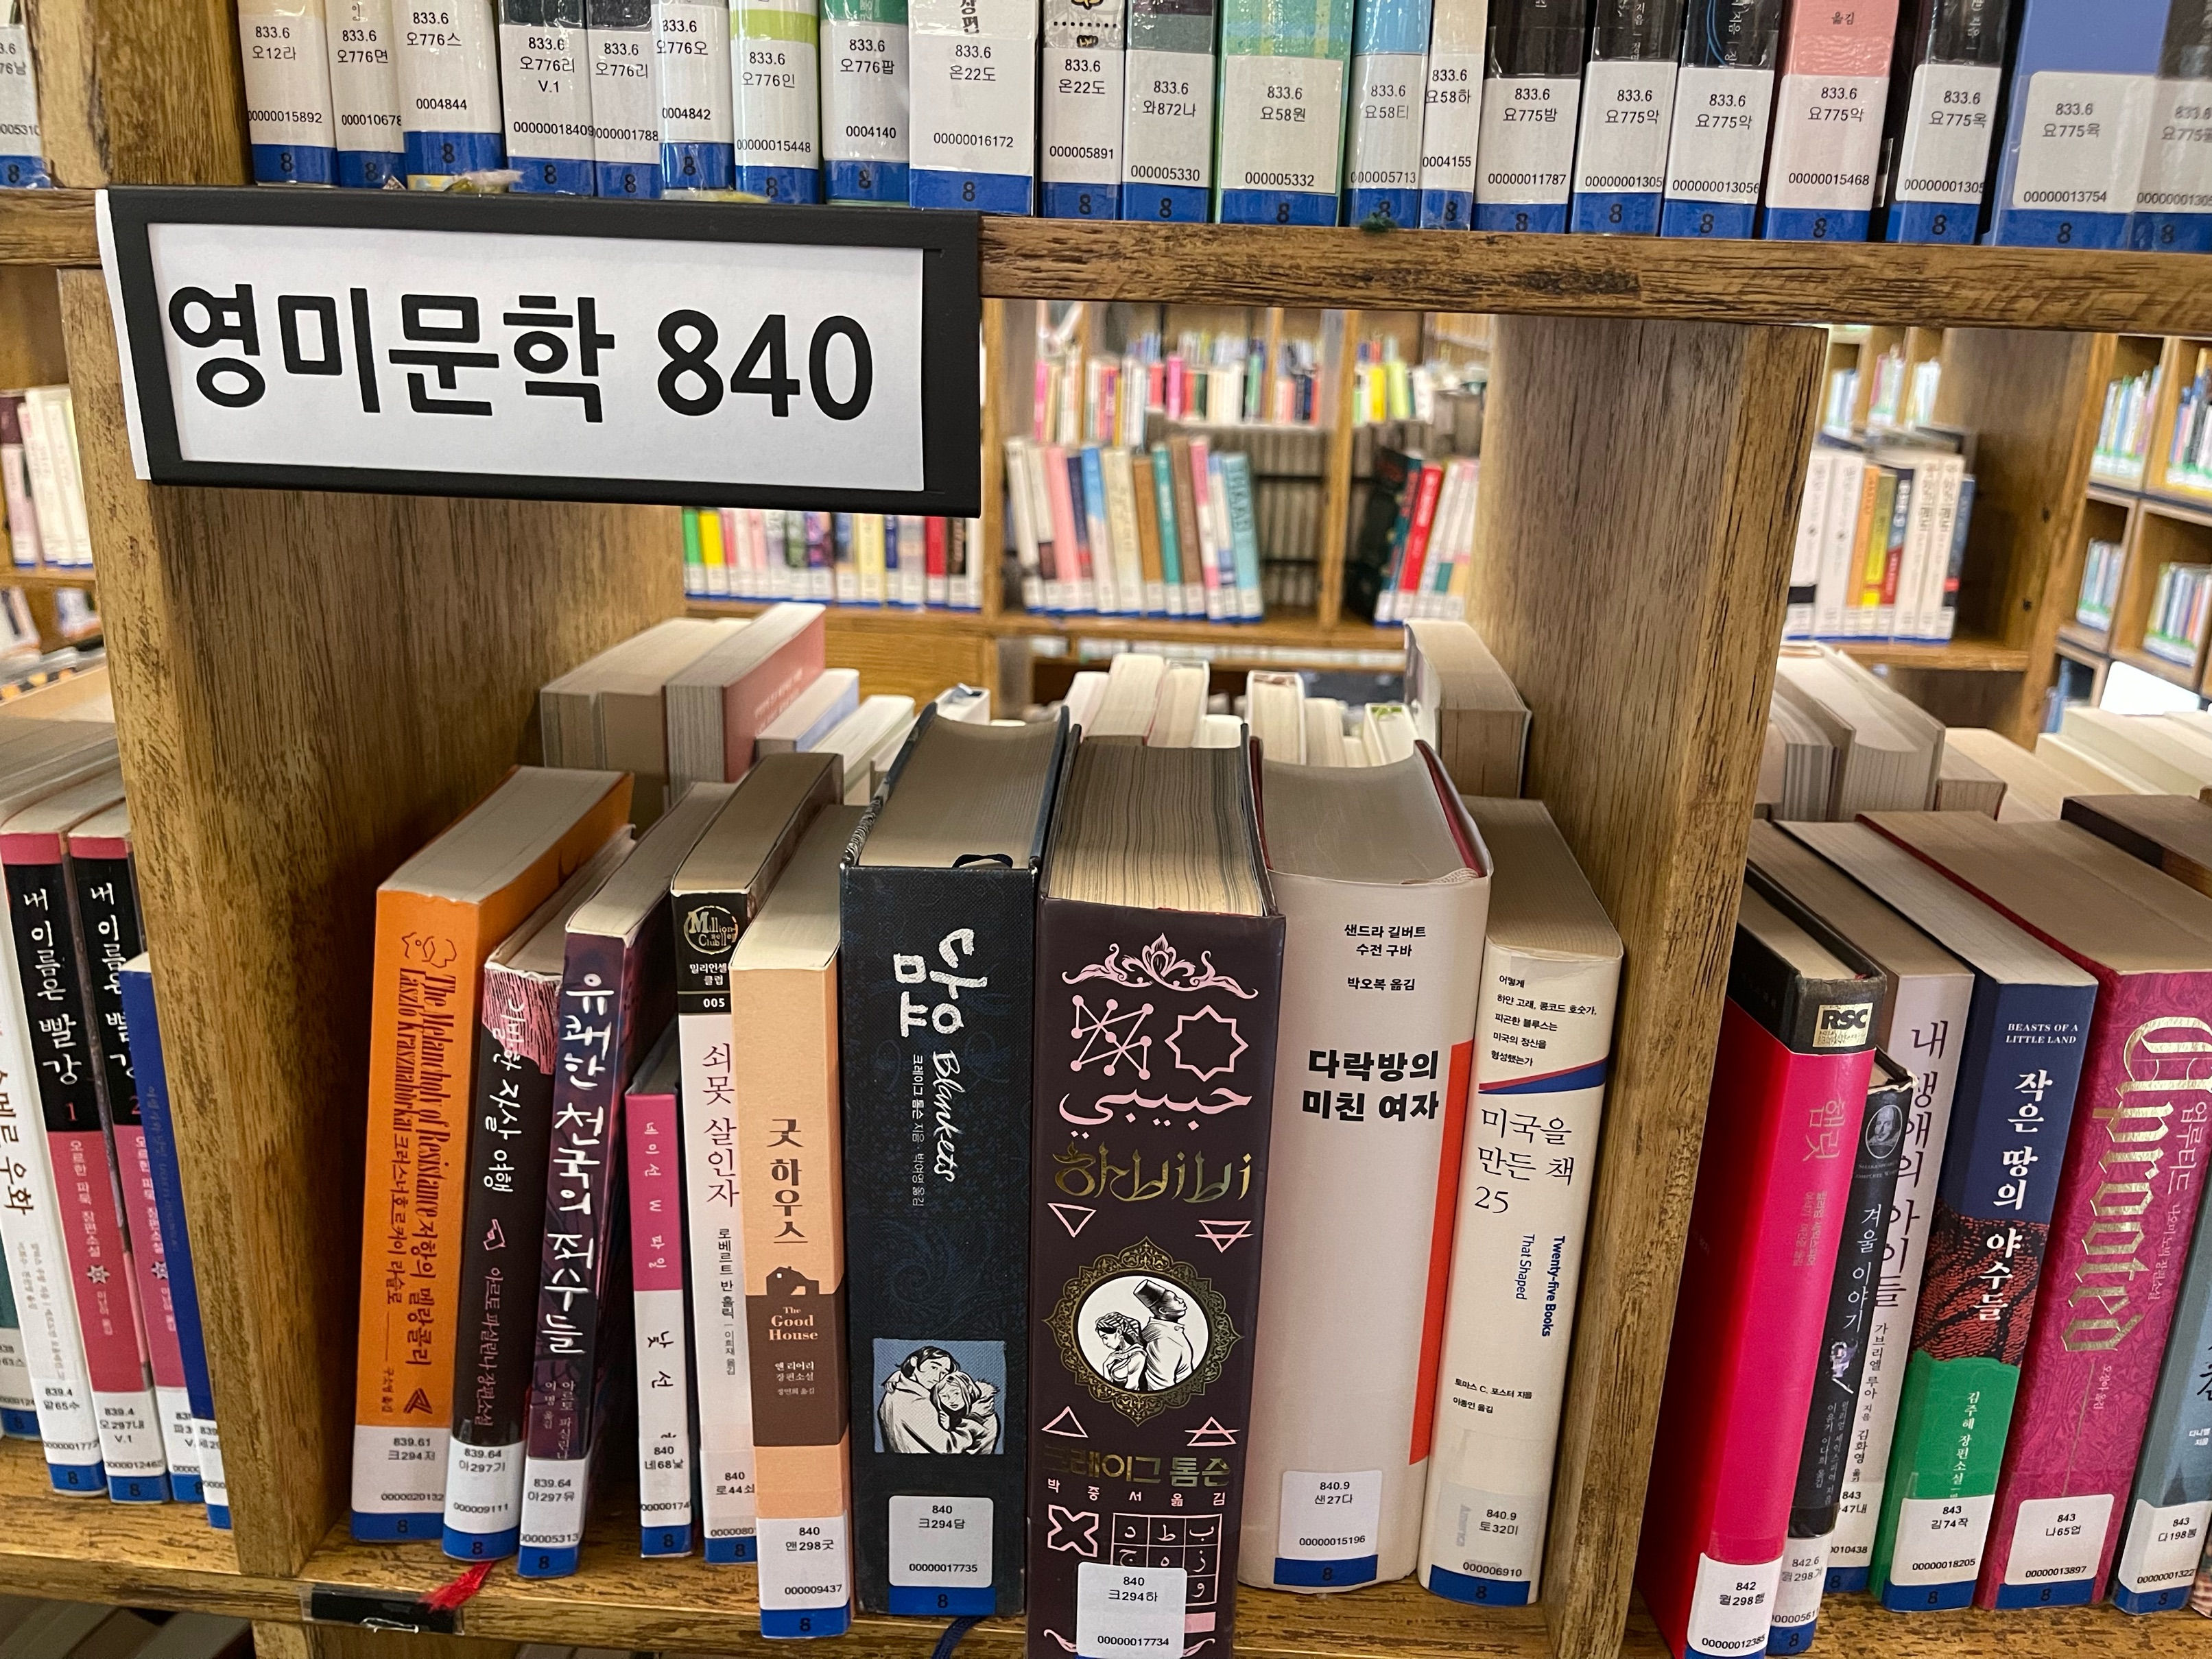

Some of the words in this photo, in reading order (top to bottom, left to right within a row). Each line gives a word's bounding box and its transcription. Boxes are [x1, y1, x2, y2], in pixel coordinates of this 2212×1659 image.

[413, 12, 449, 25] 833.6
[255, 26, 290, 40] 833.6
[342, 29, 377, 43] 833.6
[406, 32, 463, 47] 오776스
[527, 36, 565, 51] 833.6
[604, 42, 639, 56] 833.6
[848, 38, 885, 53] 833.6
[252, 46, 297, 61] 오12라
[337, 49, 389, 65] 오776면
[749, 51, 786, 67] 833.6
[955, 45, 992, 60] 833.6
[519, 56, 575, 73] 오776리
[595, 62, 649, 80] 오776리
[840, 59, 895, 75] 오776팝
[1065, 58, 1101, 73] 833.6
[741, 72, 796, 89] 오776인
[949, 65, 997, 82] 온22도
[1431, 69, 1468, 82] 833.6
[538, 79, 560, 94] V.1
[1058, 79, 1106, 95] 온22도
[1153, 80, 1189, 95] 833.6
[1267, 86, 1303, 101] 833.6
[1370, 84, 1406, 98] 833.6
[1820, 86, 1858, 101] 833.6
[1425, 88, 1472, 105] 요58하
[1514, 88, 1551, 102] 833.6
[1617, 89, 1653, 102] 833.6
[1709, 93, 1746, 108] 833.6
[1942, 91, 1982, 106] 833.6
[416, 97, 468, 111] 0004844
[1143, 100, 1197, 118] 와872나
[2054, 103, 2094, 117] 833.6
[662, 107, 711, 121] 0004842
[1364, 105, 1410, 121] 요58티
[1503, 107, 1558, 123] 요775밤
[1604, 109, 1661, 126] 요775악
[1807, 106, 1865, 123] 요775악
[1695, 113, 1753, 130] 요775악
[846, 125, 896, 139] 0004140
[933, 132, 1014, 149] 00000016172
[1049, 145, 1114, 160] 000005891
[1422, 156, 1472, 169] 0004155
[1130, 165, 1200, 182] 000005330
[1245, 171, 1315, 187] 000005332
[1487, 173, 1566, 186] 00000011787
[1787, 171, 1870, 187] 00000015468
[2023, 190, 2108, 205] 00000013754
[168, 282, 616, 423] 영미문학
[656, 309, 874, 420] 840
[1344, 923, 1384, 939] 샌드라
[1388, 925, 1427, 939] 길버트
[1355, 943, 1382, 957] 수전
[1386, 944, 1413, 957] 구바
[31, 920, 67, 1002] 이름은
[426, 974, 457, 1007] The
[893, 927, 988, 1038] 담요
[1346, 977, 1387, 991] 박오복
[1390, 978, 1416, 992] 옮김
[702, 997, 726, 1008] 005
[1820, 1008, 1870, 1031] RSC
[2008, 1023, 2052, 1032] BEASTS
[492, 999, 526, 1071] 기발한
[558, 972, 615, 1090] 유쾌한
[1911, 1020, 1949, 1060] 내
[2005, 1035, 2045, 1045] LITTLE
[2047, 1036, 2077, 1045] LAND
[38, 1013, 83, 1086] 빨강
[418, 1010, 455, 1106] Melancholy
[1307, 1049, 1440, 1082] 다락방의
[702, 1042, 735, 1106] 쇠못
[912, 1053, 925, 1096] 크레이그
[486, 1077, 523, 1141] 자살
[1302, 1090, 1366, 1123] 미친
[1378, 1090, 1440, 1123] 여자
[2007, 1069, 2053, 1133] 작은
[68, 1101, 78, 1121] 1
[932, 1049, 966, 1184] Blankets
[1059, 1087, 1252, 1138] حبيبي
[768, 1117, 805, 1148] 굿
[1481, 1108, 1573, 1147] 미국을
[1802, 1097, 1846, 1162] 햄릿
[1897, 1072, 1938, 1189] 생애의
[643, 1121, 659, 1177] 네이선
[2167, 1101, 2209, 1195] 업루티드
[552, 1101, 605, 1216] 천국의
[703, 1117, 740, 1208] 살인자
[415, 1129, 451, 1218] Resistance
[484, 1149, 514, 1193] 여행
[1477, 1147, 1537, 1182] 만든
[1545, 1156, 1575, 1187] 책
[1993, 1145, 2038, 1211] 땅의
[385, 1134, 412, 1256] 크러스너호르커이
[772, 1157, 809, 1245] 하우스
[1474, 1186, 1510, 1215] 25
[1857, 1202, 1882, 1254] 겨울
[409, 1219, 439, 1278] 저항의
[1521, 1233, 1536, 1258] That
[1876, 1198, 1922, 1309] 아이들
[1545, 1235, 1567, 1302] Twenty-five
[1973, 1226, 2023, 1322] 야수들
[385, 1261, 405, 1305] 라슬로
[484, 1266, 504, 1311] 아르토
[1514, 1259, 1532, 1302] Shaped
[540, 1232, 595, 1354] 죄수들
[1843, 1261, 1872, 1334] 이야기
[782, 1306, 802, 1315] The
[405, 1287, 435, 1366] 멜랑콜리
[770, 1314, 815, 1328] Good
[1541, 1303, 1558, 1337] Books
[479, 1313, 501, 1369] 파실린나
[769, 1328, 820, 1341] House
[1869, 1323, 1889, 1372] 가브리엘
[45, 1387, 73, 1398] 839.4
[474, 1371, 497, 1427] 장편소설
[104, 1407, 135, 1418] 839.4
[654, 1446, 675, 1456] 840
[1041, 1445, 1161, 1484] 크레이그
[1169, 1455, 1231, 1488] 톰슨
[1951, 1434, 1973, 1485] 장편소설
[724, 1471, 746, 1481] 840
[1320, 1481, 1351, 1491] 840.9
[1842, 1491, 1862, 1501] 843
[932, 1505, 953, 1515] 840
[1486, 1509, 1517, 1521] 840.9
[1942, 1505, 1962, 1515] 843
[2057, 1513, 2076, 1523] 843
[918, 1518, 966, 1530] 크294담
[1479, 1522, 1519, 1537] 토32미
[1931, 1516, 1969, 1530] 김74작
[2172, 1517, 2190, 1527] 843
[798, 1526, 821, 1536] 840
[785, 1538, 835, 1553] 앤298굿
[1299, 1534, 1366, 1547] 00000015196
[909, 1563, 978, 1573] 00000017735
[1792, 1555, 1820, 1568] 842.6
[1912, 1558, 1976, 1571] 00000018205
[1462, 1562, 1523, 1578] 000006910
[2025, 1566, 2087, 1579] 00000013897
[1123, 1575, 1145, 1587] 840
[1735, 1581, 1757, 1592] 842
[1108, 1589, 1158, 1603] 크294하
[1097, 1635, 1170, 1648] 00000017734
